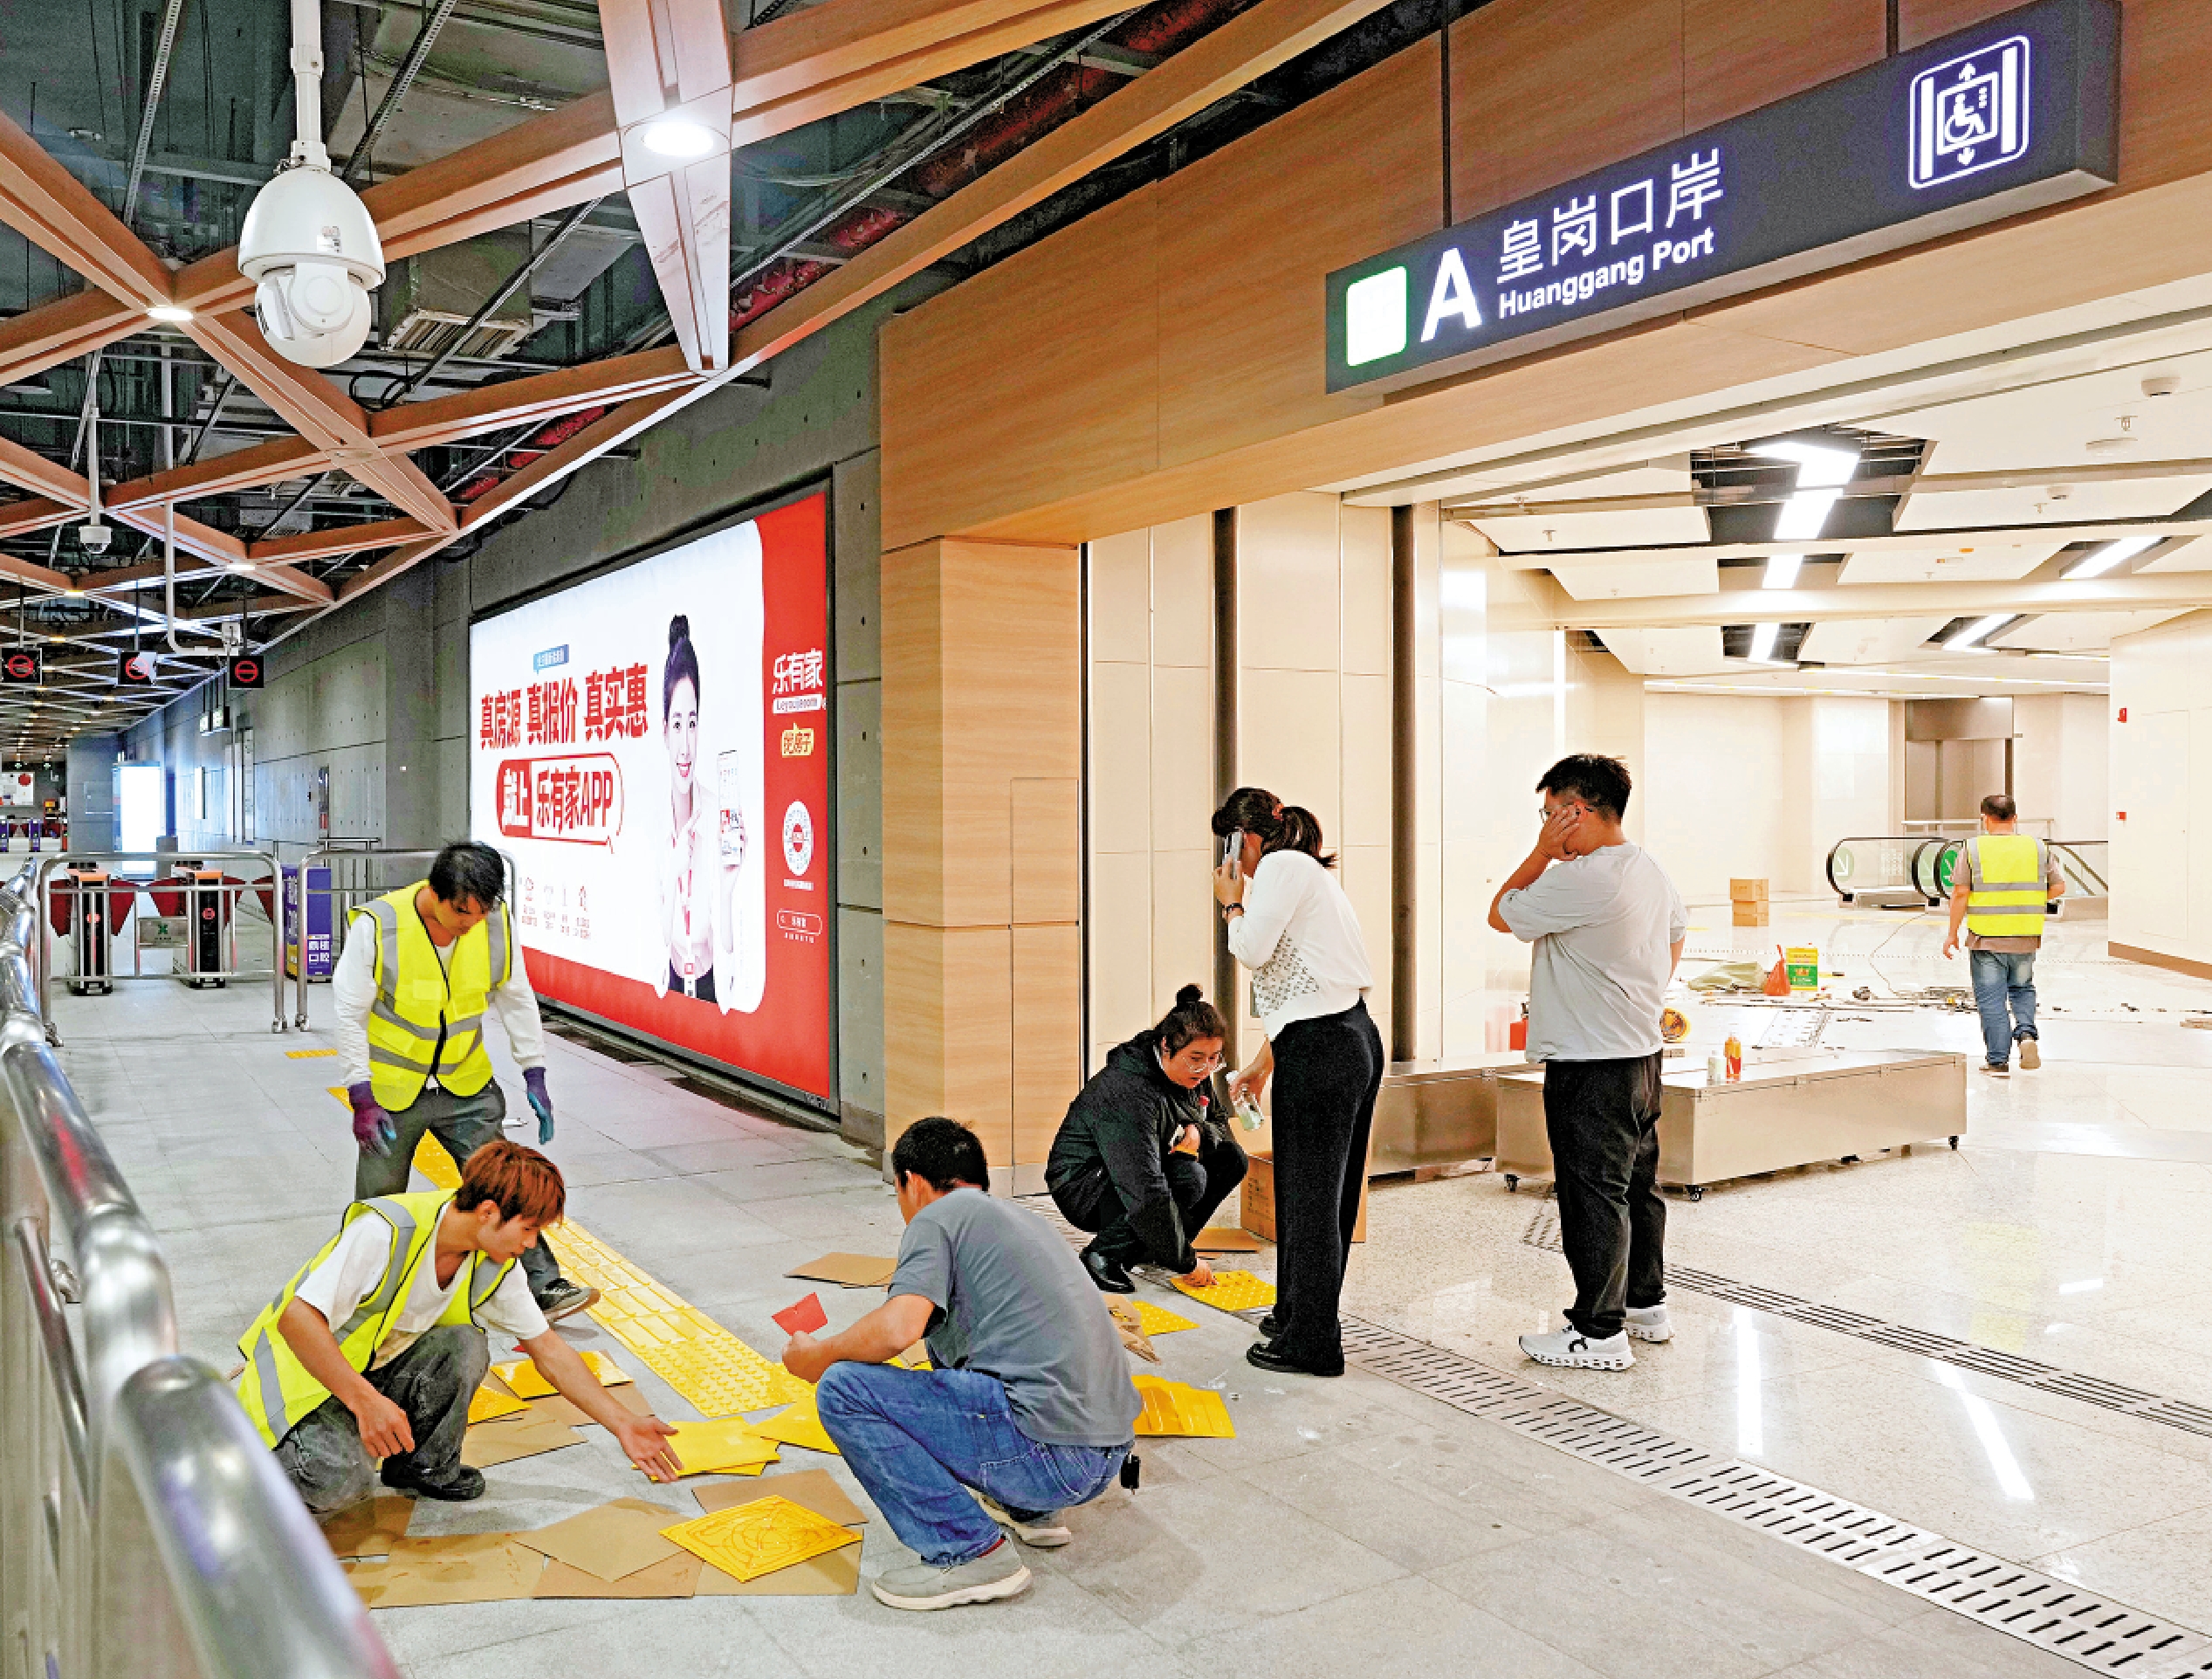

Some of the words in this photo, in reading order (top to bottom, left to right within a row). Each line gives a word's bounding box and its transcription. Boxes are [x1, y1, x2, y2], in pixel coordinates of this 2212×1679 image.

[1496, 147, 1724, 285] 皇岗口岸
[1420, 246, 1483, 342] A
[1498, 253, 1645, 320] Huanggang
[1652, 225, 1715, 271] Port
[479, 688, 521, 751] 真房源
[526, 677, 579, 746] 真报价
[583, 662, 649, 742] 真实惠
[772, 647, 823, 695] 乐有家
[536, 764, 614, 836] 乐有家APP
